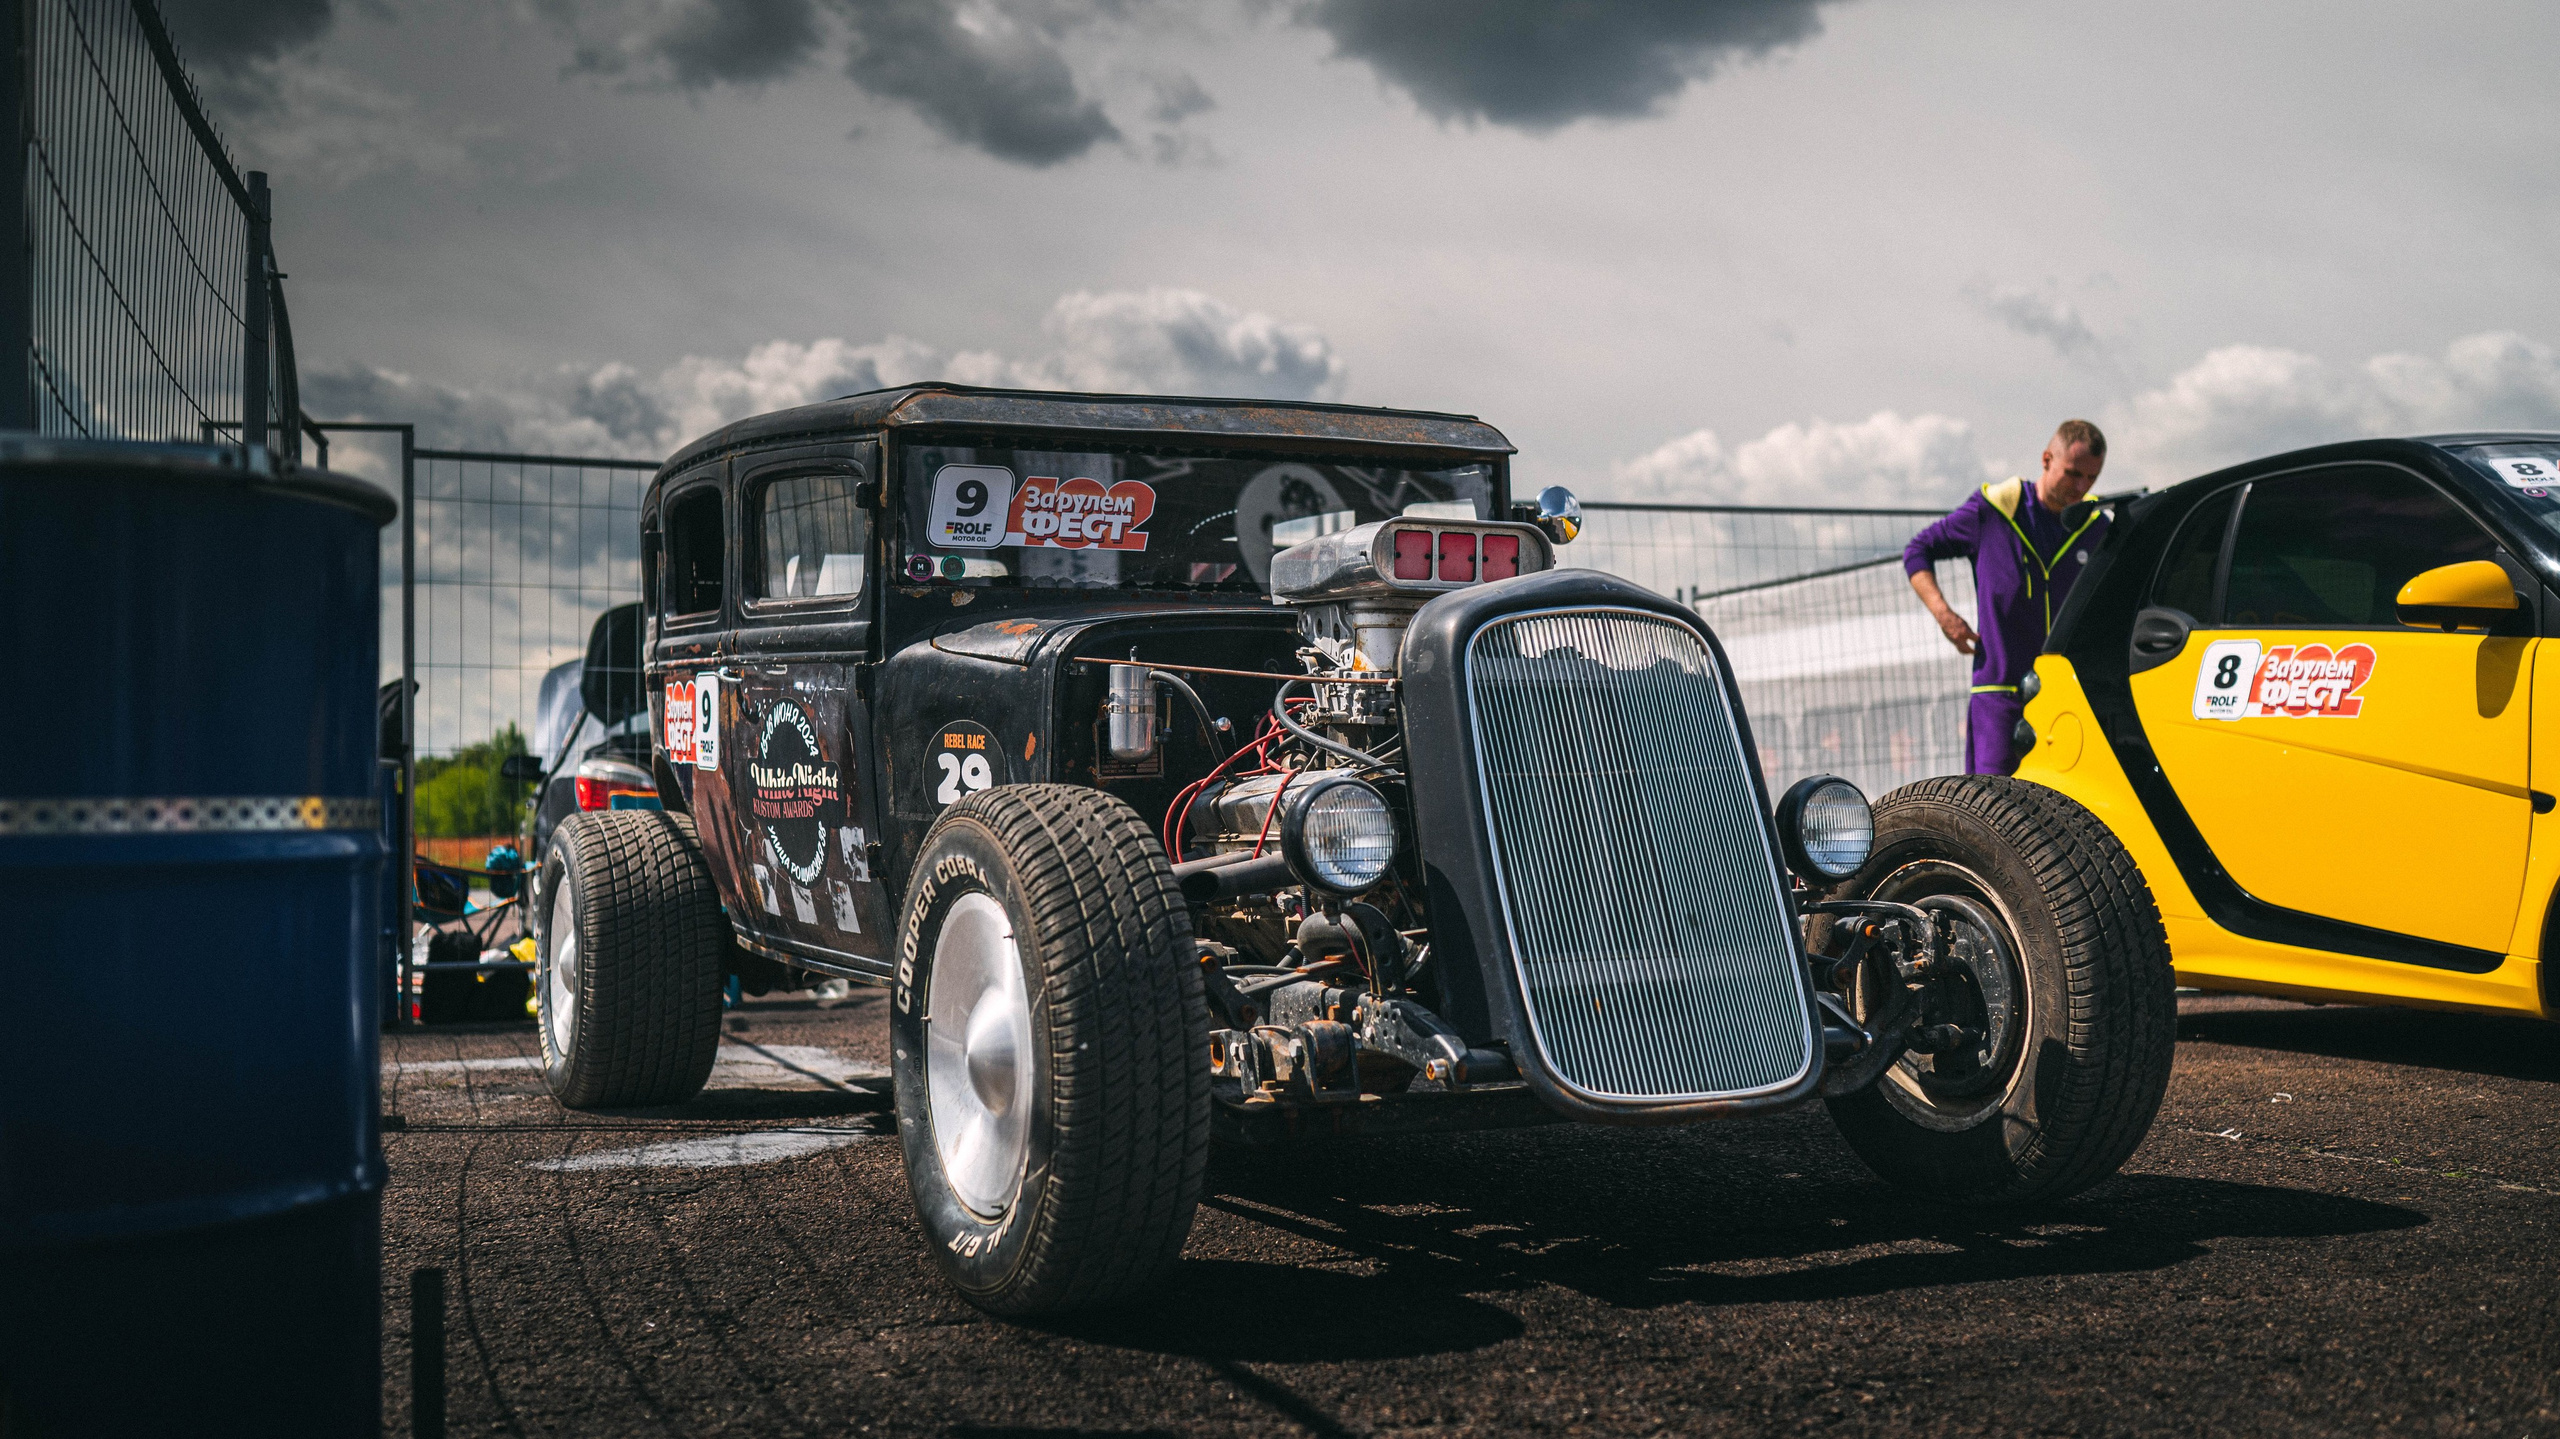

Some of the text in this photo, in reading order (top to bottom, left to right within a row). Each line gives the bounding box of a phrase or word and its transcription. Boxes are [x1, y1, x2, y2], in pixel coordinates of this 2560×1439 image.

[2511, 463, 2544, 475] 8
[956, 480, 989, 517] 9
[953, 522, 992, 535] ROLF
[1021, 510, 1133, 542] ФЕСТ
[2214, 655, 2241, 689] 8
[2211, 696, 2238, 706] ROLF
[2260, 679, 2352, 708] ФЕСТ
[702, 690, 711, 733] 9
[797, 716, 819, 757] 2024
[944, 733, 986, 750] REBEL RACE
[938, 752, 992, 804] 29
[753, 797, 815, 818] KUSTOM AWARDS
[767, 825, 790, 869] УЛИЦА
[897, 855, 990, 1015] COOPER COBRA
